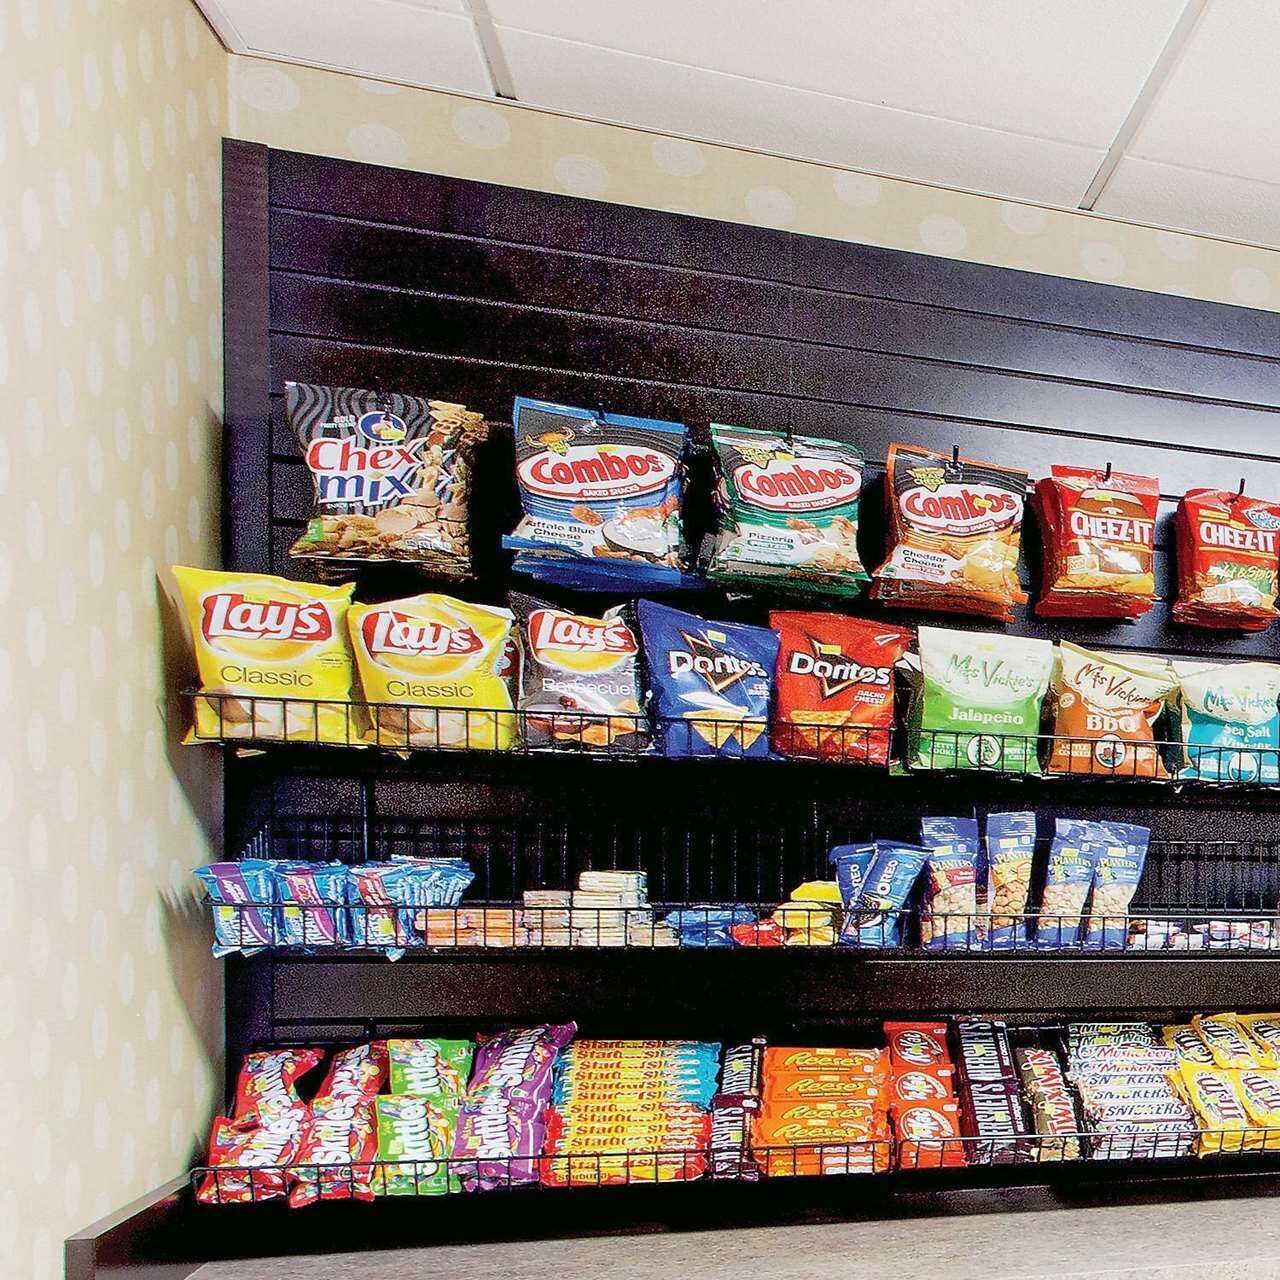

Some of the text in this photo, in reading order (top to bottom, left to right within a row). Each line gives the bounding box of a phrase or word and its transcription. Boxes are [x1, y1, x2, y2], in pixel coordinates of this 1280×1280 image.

[308, 437, 416, 472] Chex
[531, 452, 663, 485] Combos
[319, 475, 412, 503] mix
[741, 465, 854, 497] Combos
[905, 490, 1017, 521] Combos
[534, 528, 582, 541] Cheese
[569, 525, 596, 535] Blue
[748, 532, 794, 544] Pizzeria
[1071, 512, 1152, 545] CHEEZ-IT
[1200, 522, 1275, 552] CHEEZ-IT
[902, 549, 947, 564] Cheddar
[904, 557, 944, 569] Cheese
[1248, 565, 1276, 583] Spicy
[671, 651, 768, 677] Doritos
[791, 653, 890, 685] Doritos
[221, 665, 313, 687] Classic
[386, 680, 474, 698] Classic
[543, 678, 631, 697] Barbecue
[854, 695, 885, 705] CHEESE
[948, 707, 1025, 725] Jalapeño
[1086, 716, 1137, 732] BBQ
[1224, 723, 1271, 738] Sea Salt
[1099, 857, 1138, 869] PLANTERS
[877, 859, 898, 896] OREO
[1123, 1033, 1151, 1045] Way
[487, 1028, 546, 1087] Skittles
[784, 1052, 864, 1066] Reese's
[960, 1023, 1003, 1080] HERSHEY'S
[405, 1045, 441, 1096] ittles
[1089, 1074, 1165, 1085] SNKERS
[786, 1078, 865, 1092] Reese's
[782, 1105, 864, 1119] Reese's
[238, 1110, 305, 1167] Skittles
[312, 1095, 362, 1165] Skittles
[394, 1096, 440, 1177] Skittles
[474, 1098, 510, 1164] Skittles
[773, 1124, 854, 1138] Reese's
